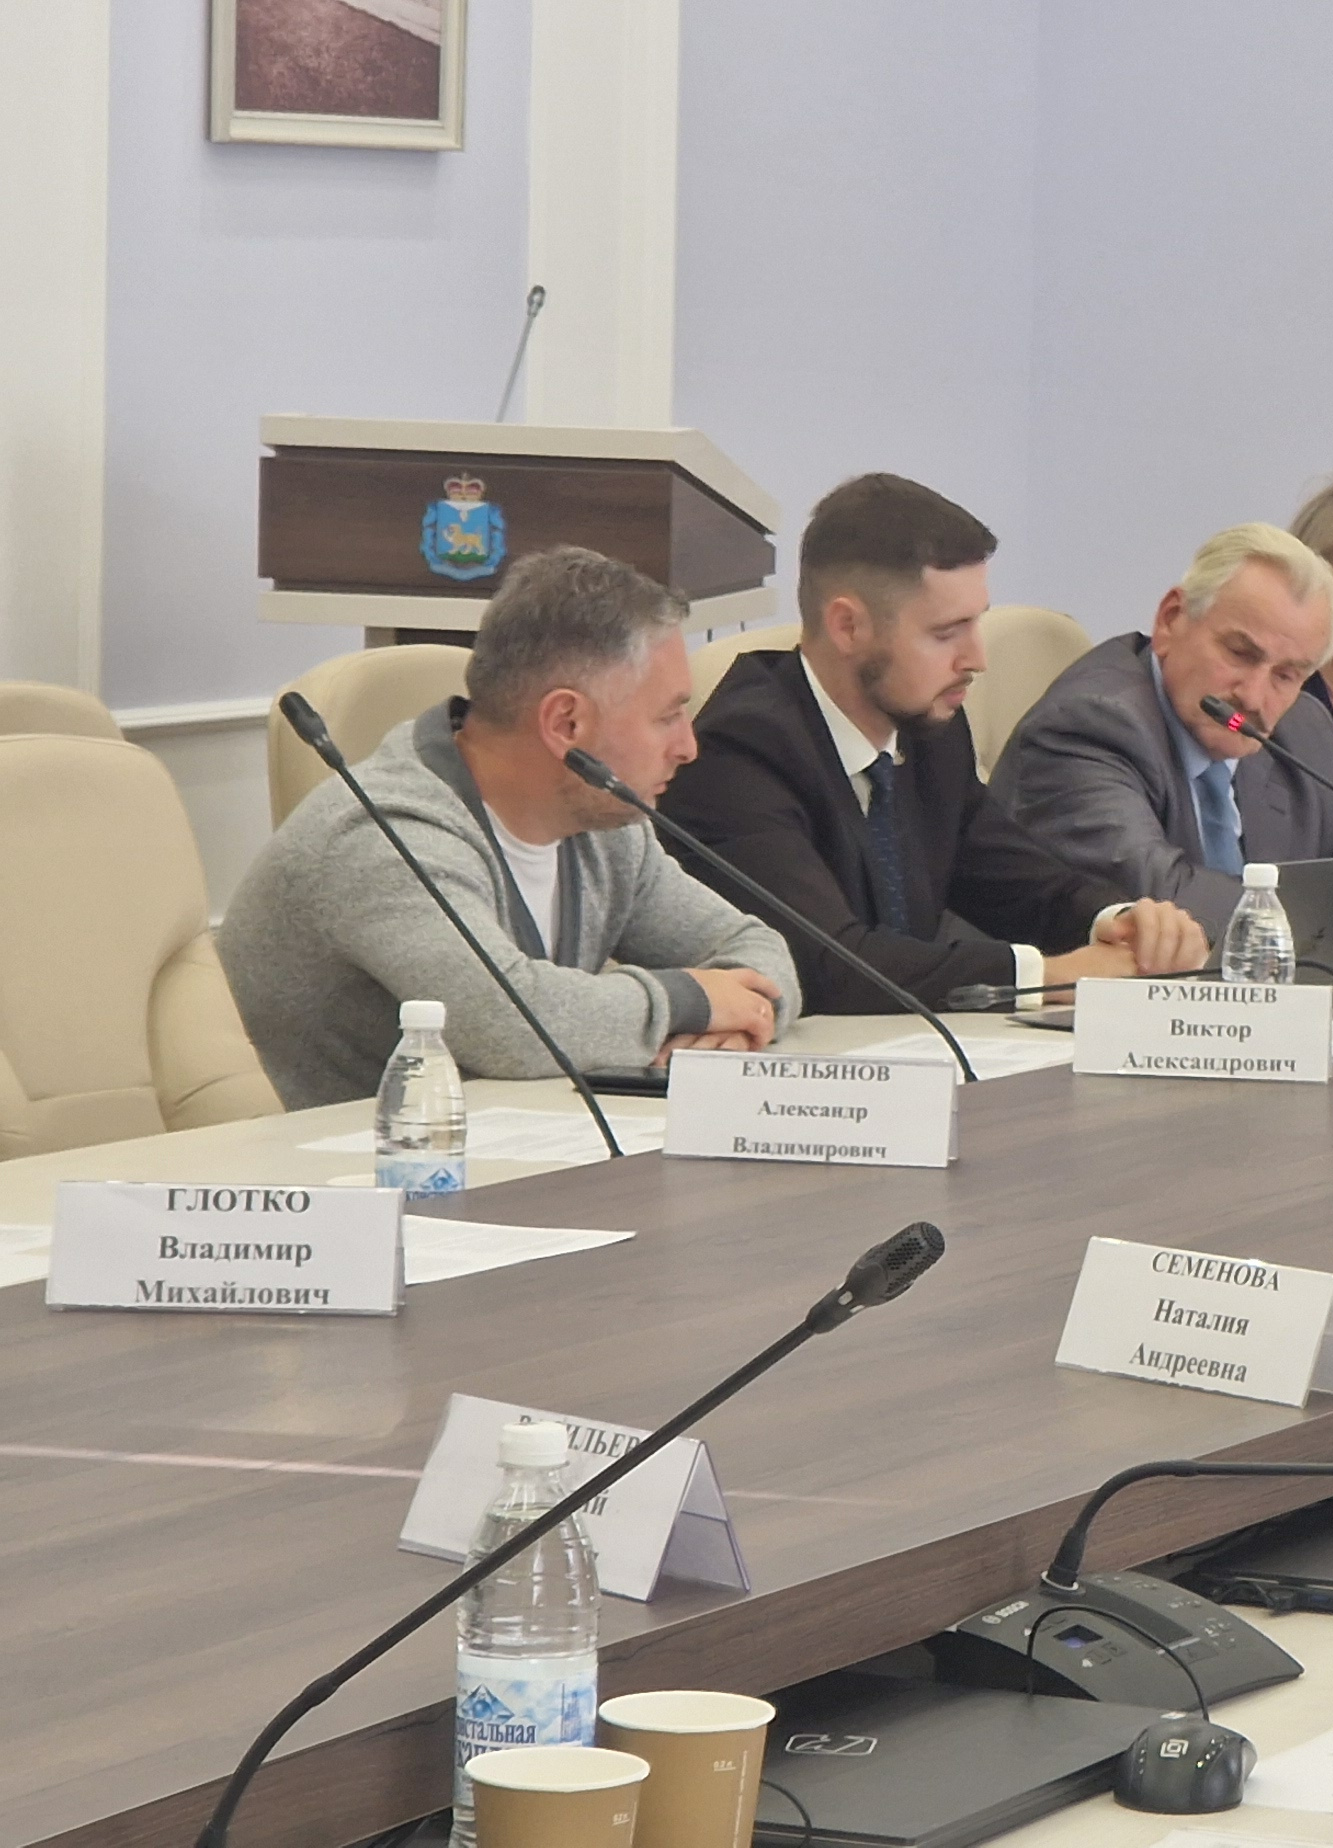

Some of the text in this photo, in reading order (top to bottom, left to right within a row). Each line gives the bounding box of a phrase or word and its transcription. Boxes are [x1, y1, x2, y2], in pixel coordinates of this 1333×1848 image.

[1147, 985, 1277, 1005] РУМЯНЦЕВ
[1170, 1019, 1251, 1042] Виктор
[742, 1061, 891, 1082] ЕМЕЛЬЯНОВ
[1122, 1051, 1296, 1075] Александрович
[758, 1100, 868, 1123] Александр
[733, 1136, 887, 1161] Владимирович
[166, 1188, 311, 1213] ГЛОТКО
[158, 1236, 312, 1267] Владимир
[1152, 1251, 1280, 1291] СЕМЕНОВА
[135, 1280, 330, 1305] Михайлович
[1153, 1298, 1250, 1336] Наталия
[1129, 1342, 1248, 1383] Андреевна
